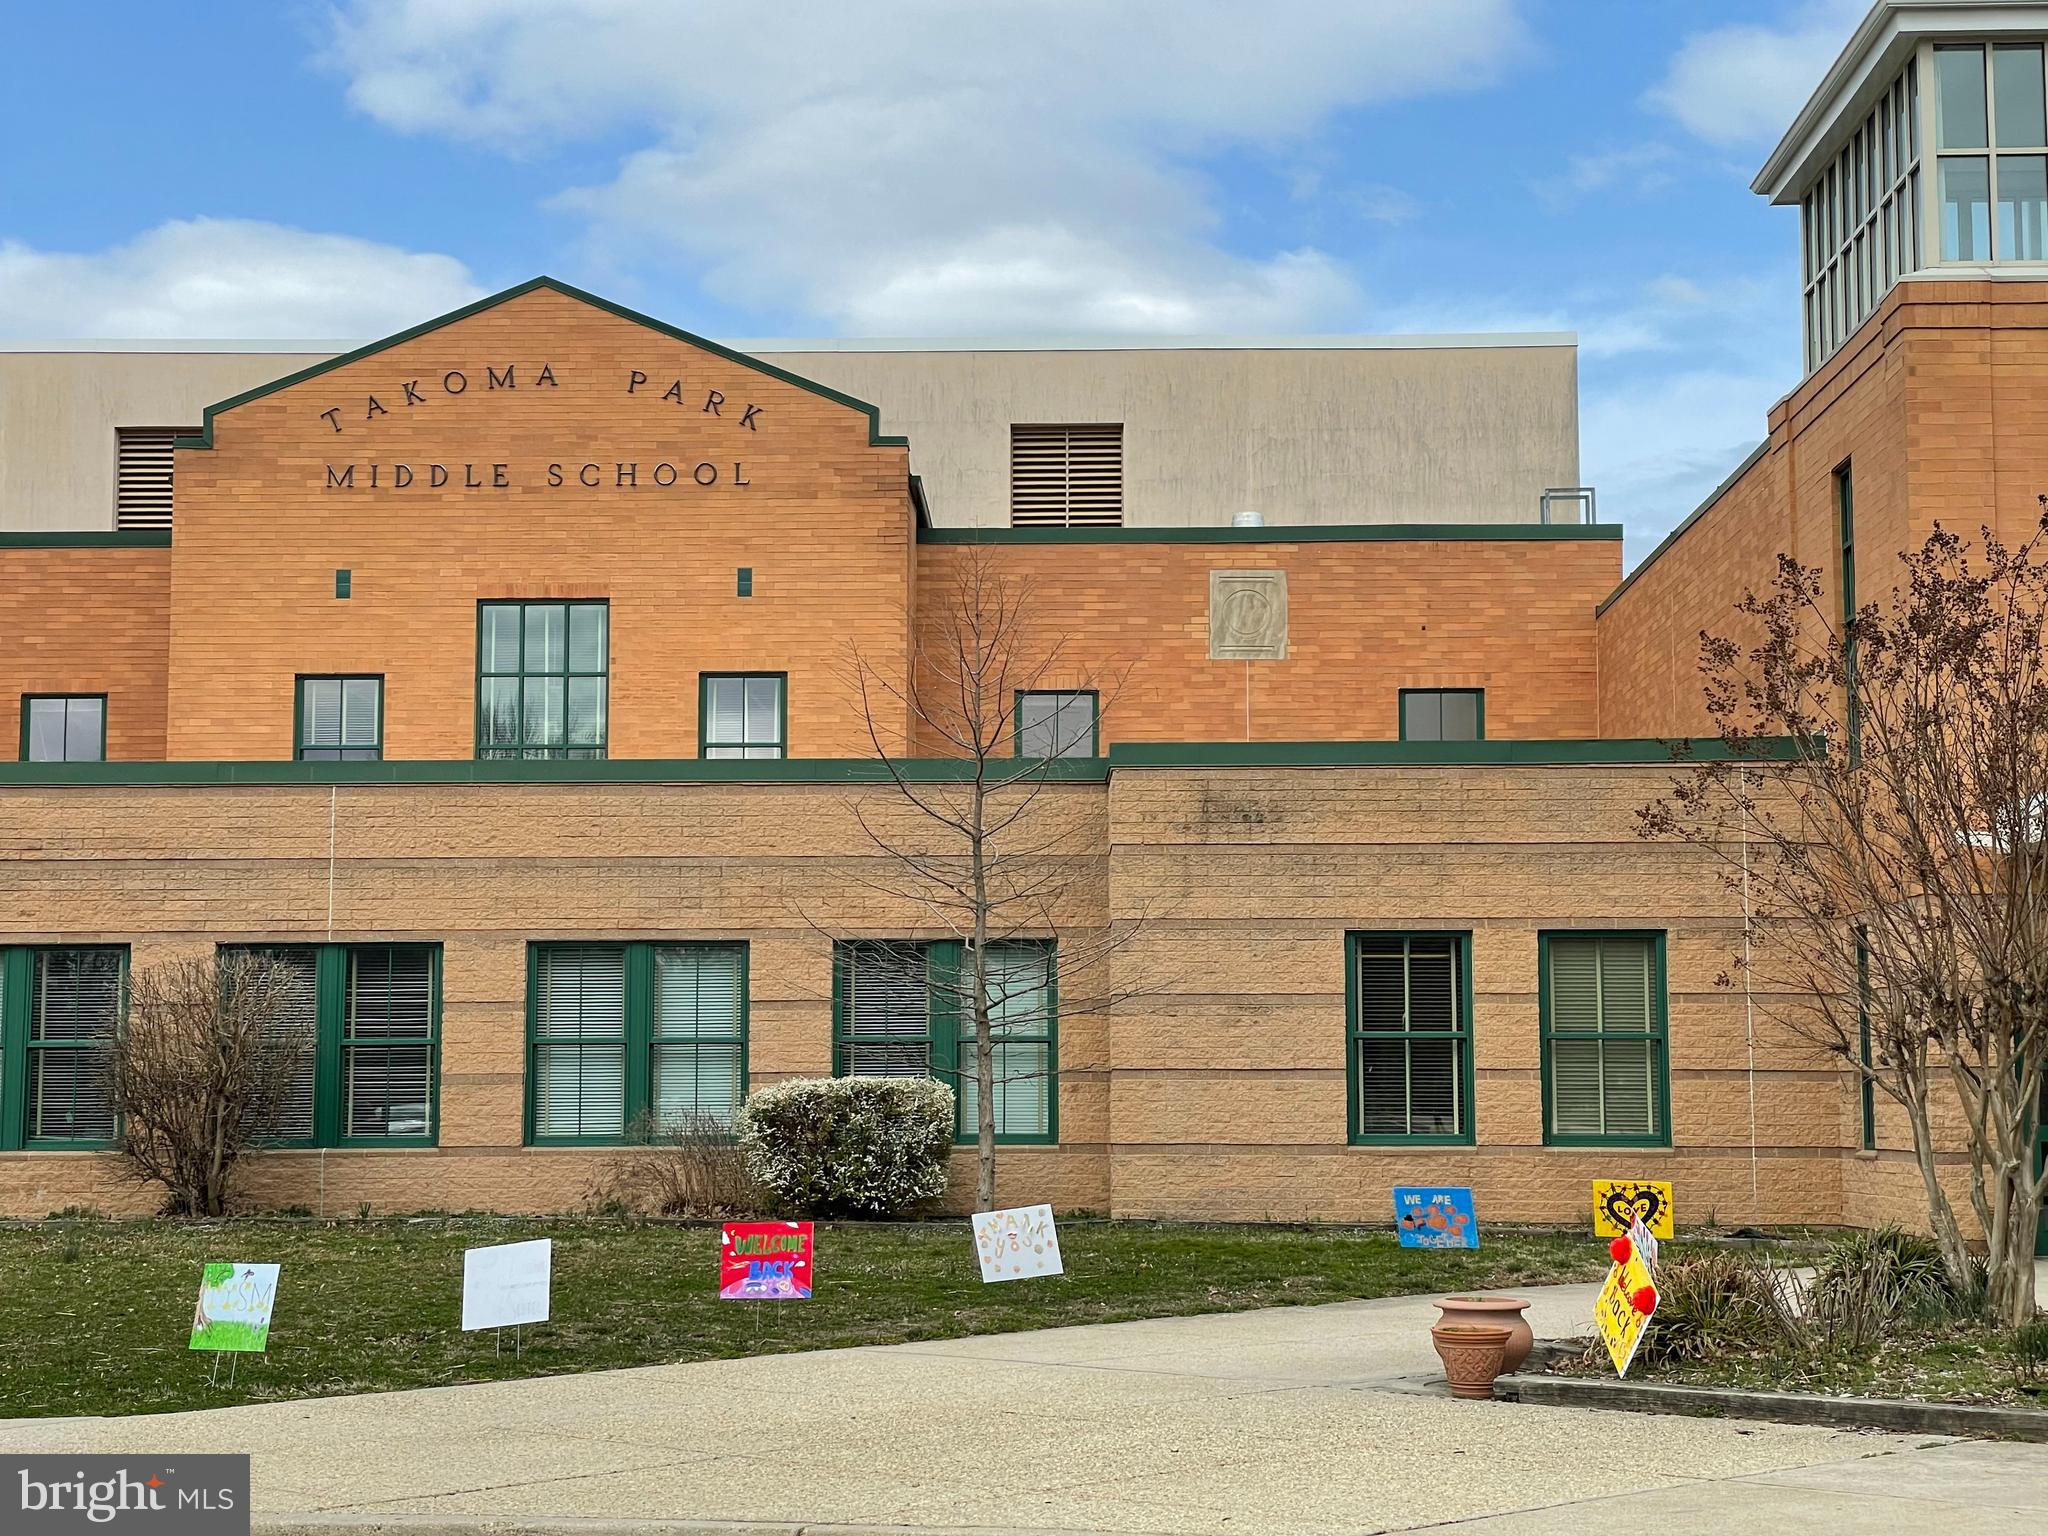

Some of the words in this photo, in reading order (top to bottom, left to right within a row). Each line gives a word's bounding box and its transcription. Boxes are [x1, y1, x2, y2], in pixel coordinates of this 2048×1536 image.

[320, 362, 558, 433] TAKOMA
[627, 369, 764, 431] PARK
[326, 463, 510, 489] MIDDLE
[547, 461, 751, 488] SCHOOL
[1403, 1194, 1422, 1205] WE
[1431, 1194, 1452, 1205] ARE
[1617, 1203, 1647, 1216] LOVE
[735, 1234, 808, 1255] WELCOME
[748, 1260, 795, 1281] BACK
